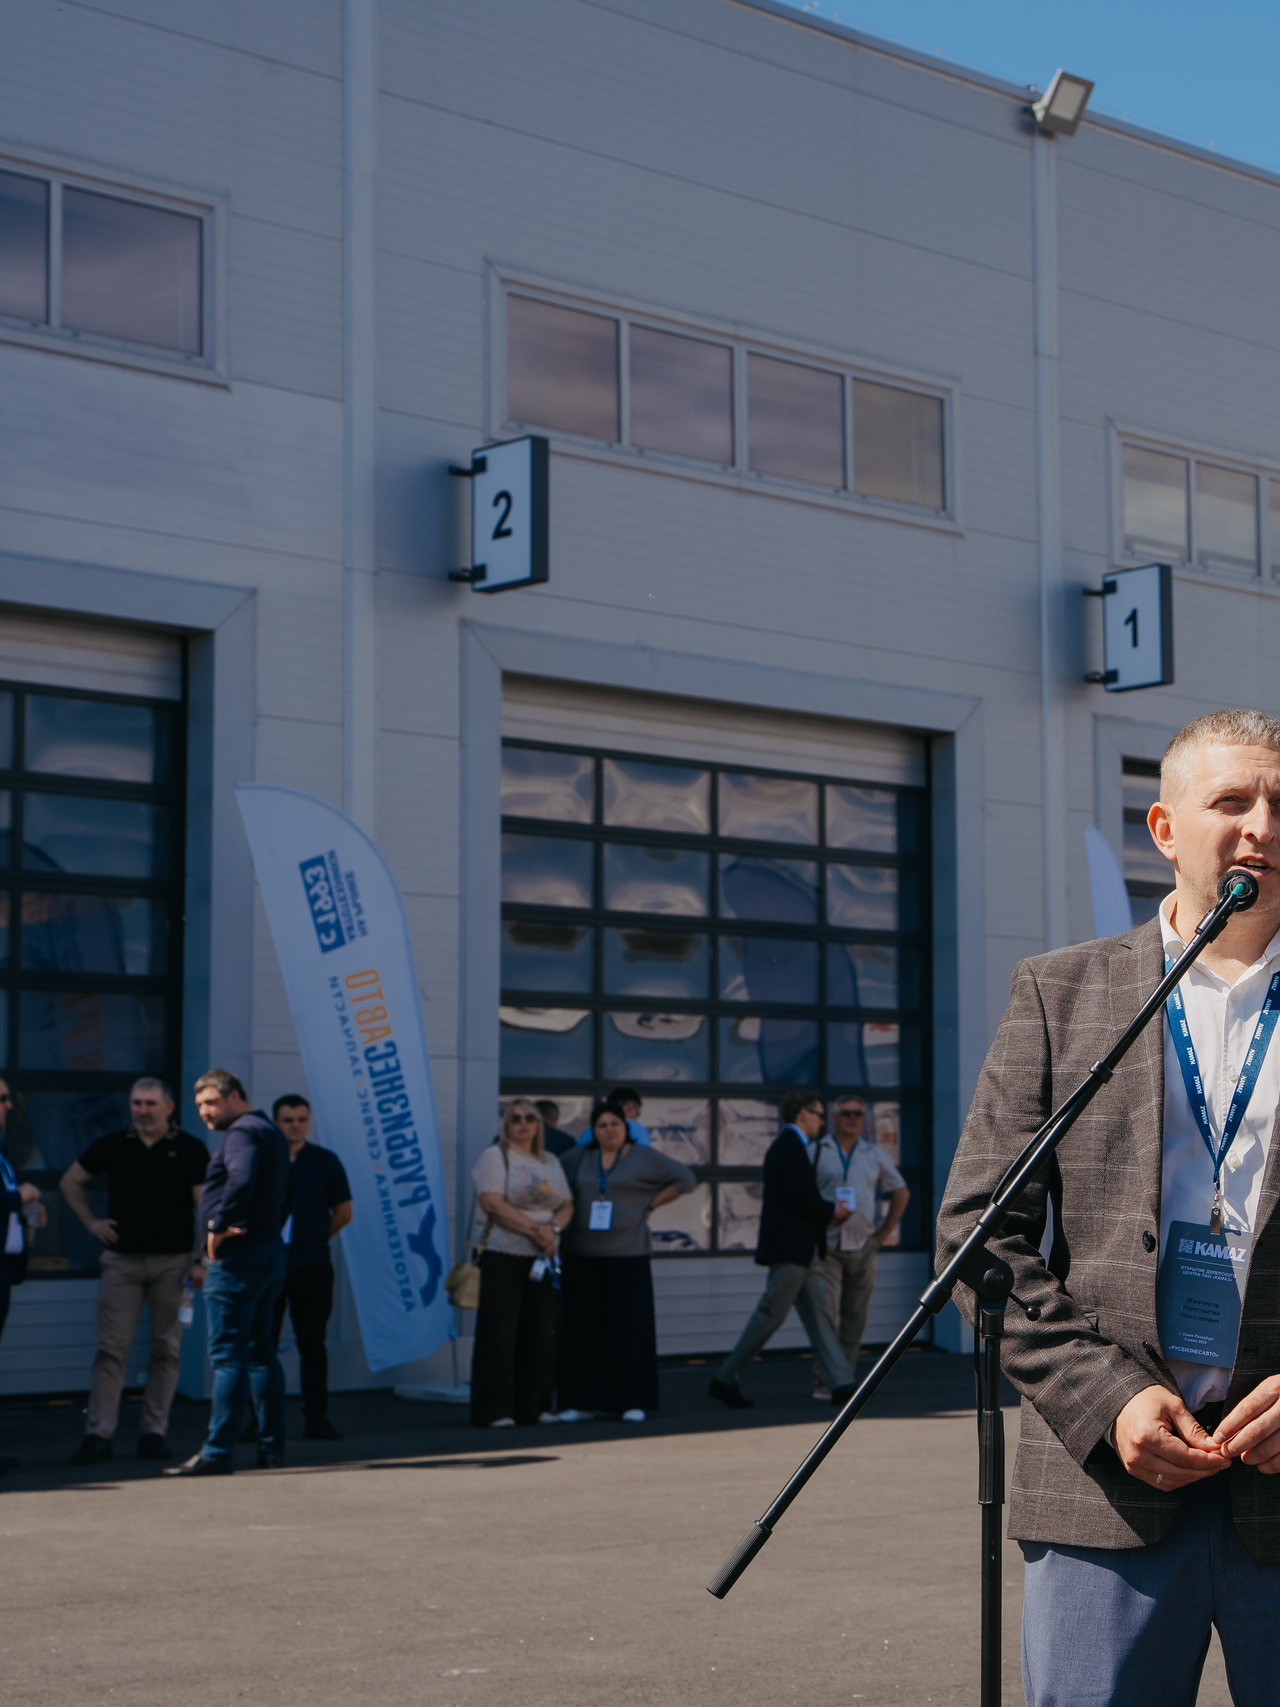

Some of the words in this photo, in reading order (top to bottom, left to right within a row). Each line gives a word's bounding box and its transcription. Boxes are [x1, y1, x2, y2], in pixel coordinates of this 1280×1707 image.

[492, 489, 513, 540] 2
[1124, 607, 1140, 648] 1
[1180, 1019, 1189, 1038] KAMAZ
[1254, 1023, 1265, 1040] KAMAZ
[1186, 1046, 1196, 1065] KAMAZ
[1245, 1048, 1255, 1066] KAMAZ
[1193, 1075, 1203, 1095] KAMAZ
[1194, 1241, 1247, 1262] KAMAZ
[1180, 1312, 1220, 1324] Николаевич
[1182, 1304, 1221, 1316] Константин
